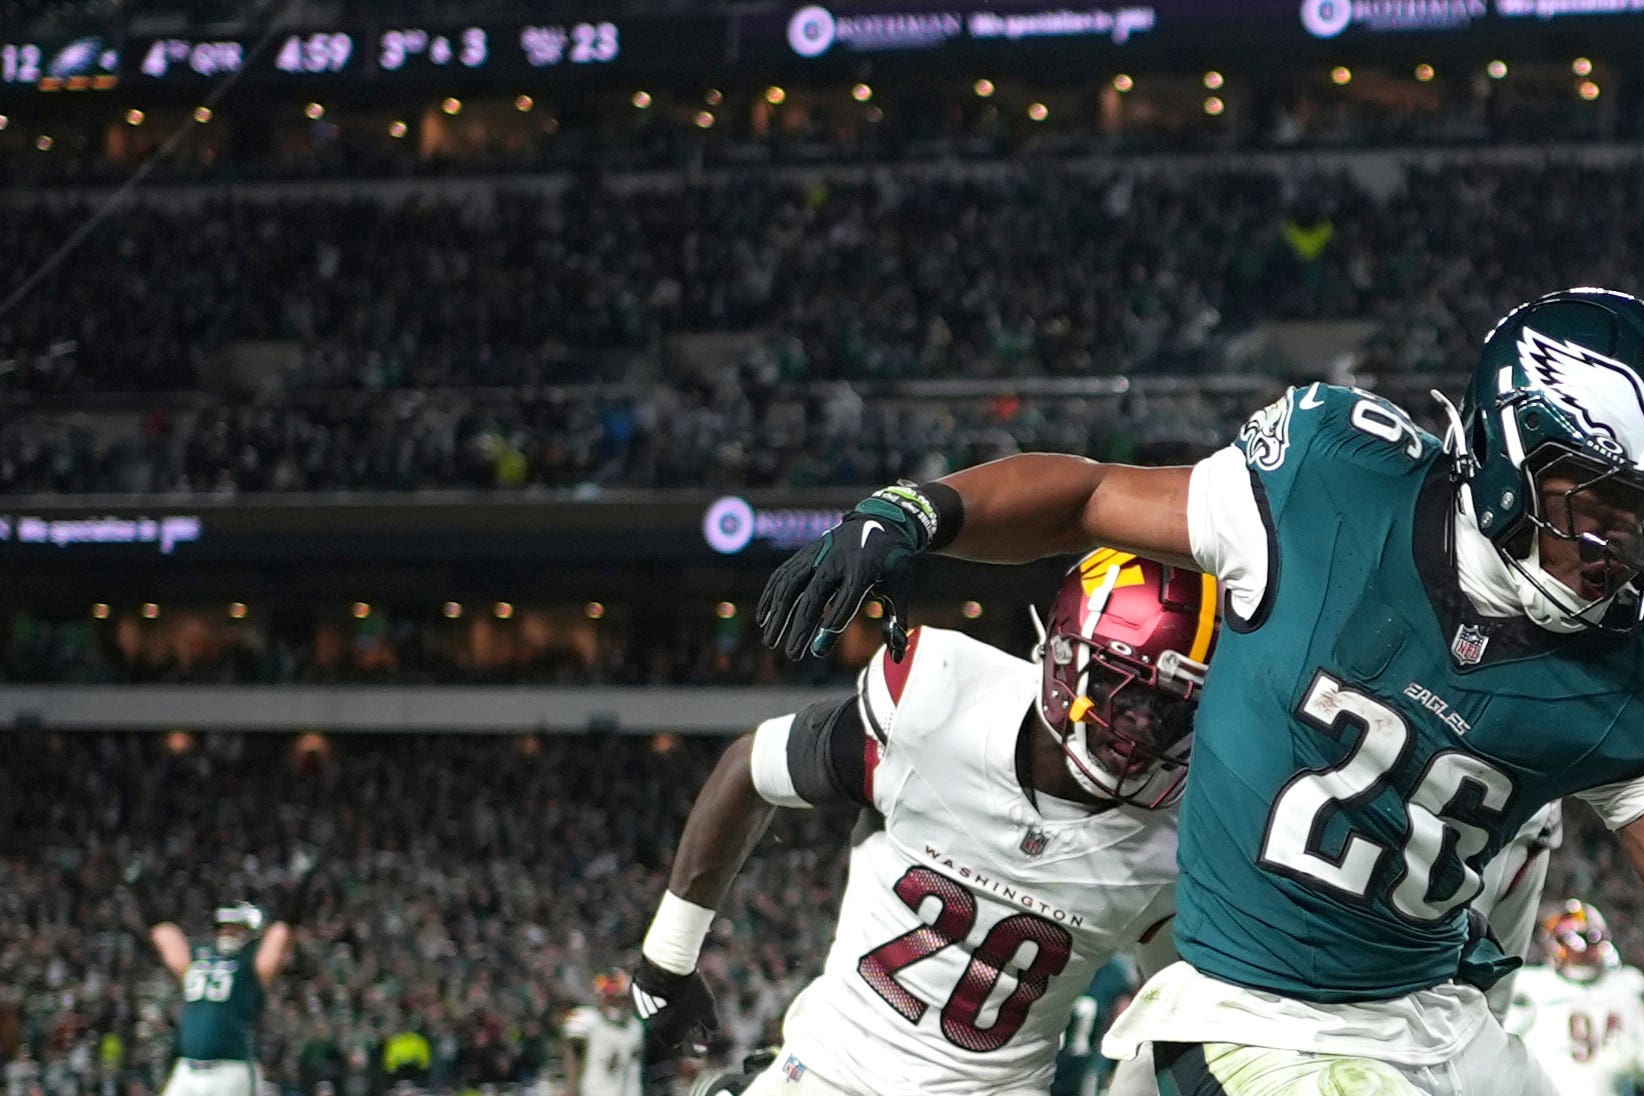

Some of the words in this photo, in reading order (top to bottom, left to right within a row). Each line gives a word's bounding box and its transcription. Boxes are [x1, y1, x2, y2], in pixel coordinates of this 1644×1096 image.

[3, 44, 41, 82] 12
[459, 27, 487, 68] 3
[569, 21, 619, 63] 23
[1403, 682, 1472, 735] EAGLES
[1261, 672, 1514, 924] 26
[925, 845, 1085, 927] WASHINGTON
[858, 864, 1074, 1053] 20
